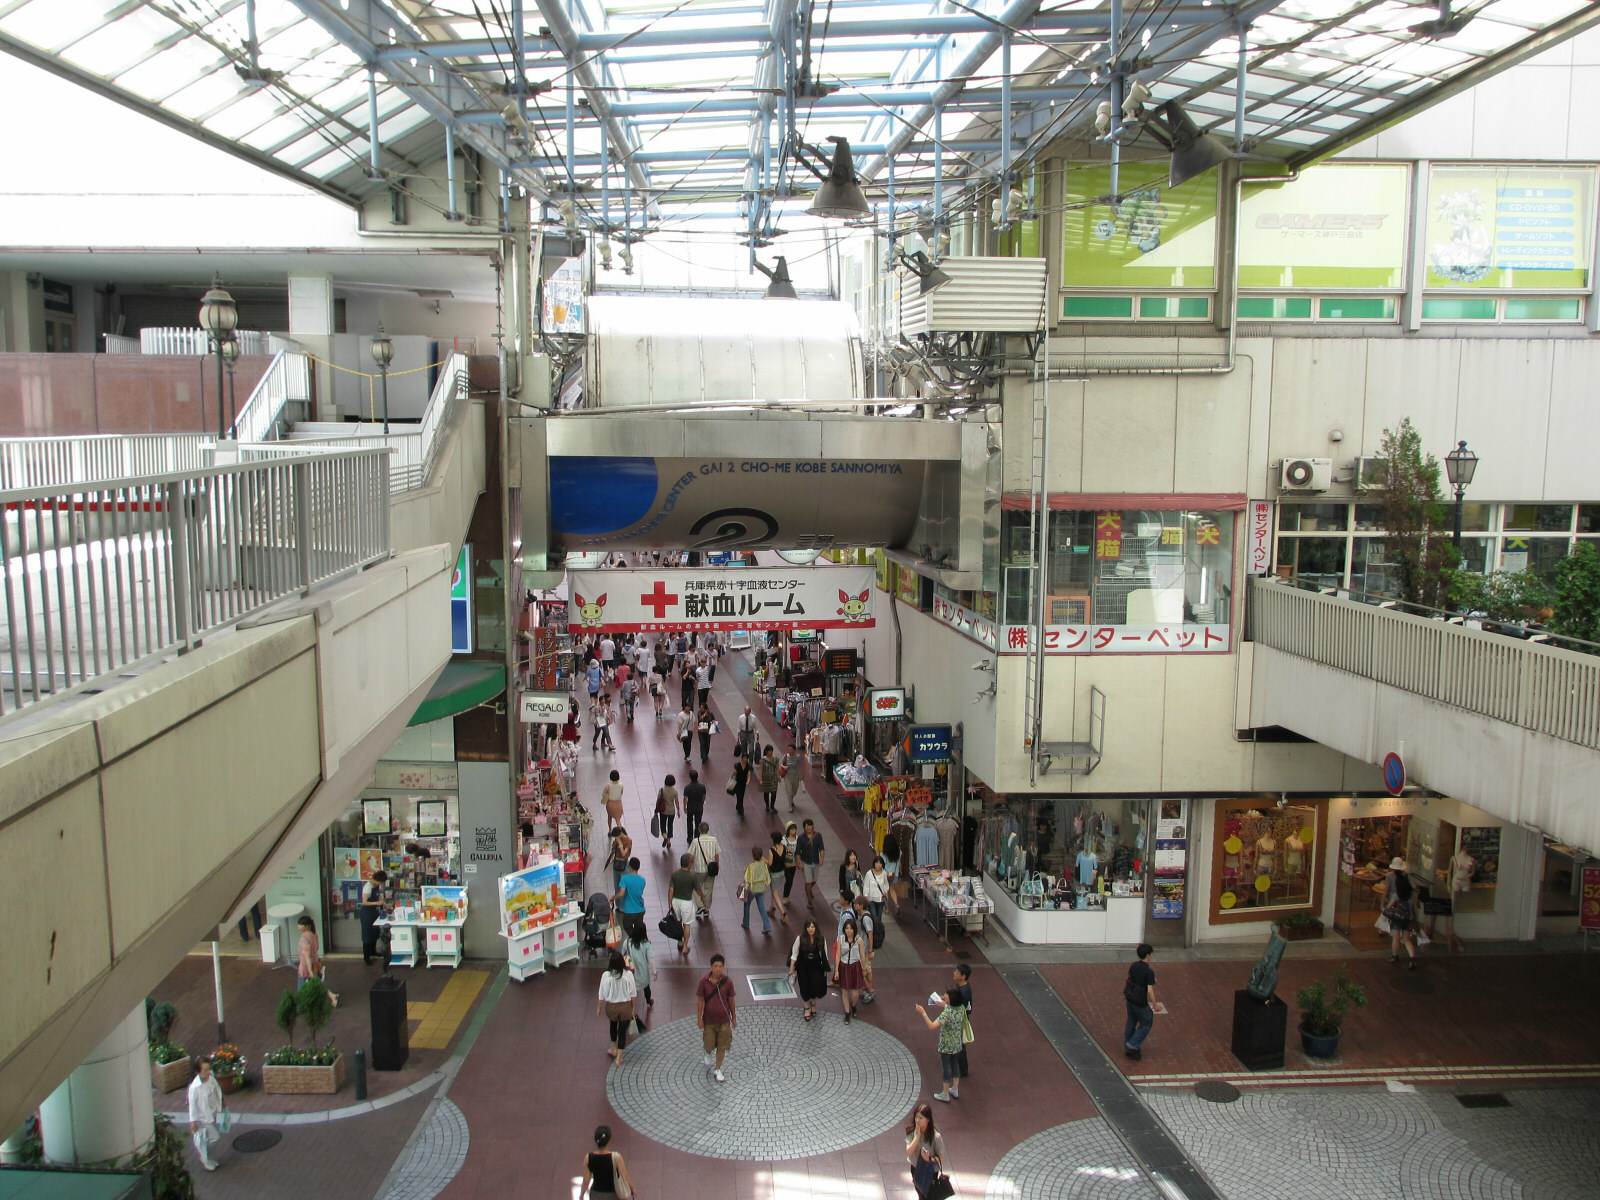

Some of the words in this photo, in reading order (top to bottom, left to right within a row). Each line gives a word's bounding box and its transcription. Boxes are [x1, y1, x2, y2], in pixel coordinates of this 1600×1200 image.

[1255, 213, 1388, 230] GAMERS
[663, 471, 697, 512] CENTER
[701, 462, 723, 475] GAI
[728, 462, 735, 472] 2
[741, 462, 791, 473] CHO-ME
[795, 462, 826, 473] KOBE
[831, 463, 902, 474] SANNOMIYA
[1162, 528, 1184, 544] 猫
[1196, 526, 1220, 545] 犬
[684, 580, 805, 590] 兵庫県赤十字血液センター
[684, 592, 805, 618] 献血ルーム
[640, 622, 720, 630] 献血ルームのある街
[525, 702, 563, 712] REGALO
[919, 742, 948, 751] カツウラ
[470, 853, 503, 862] GALLERIA
